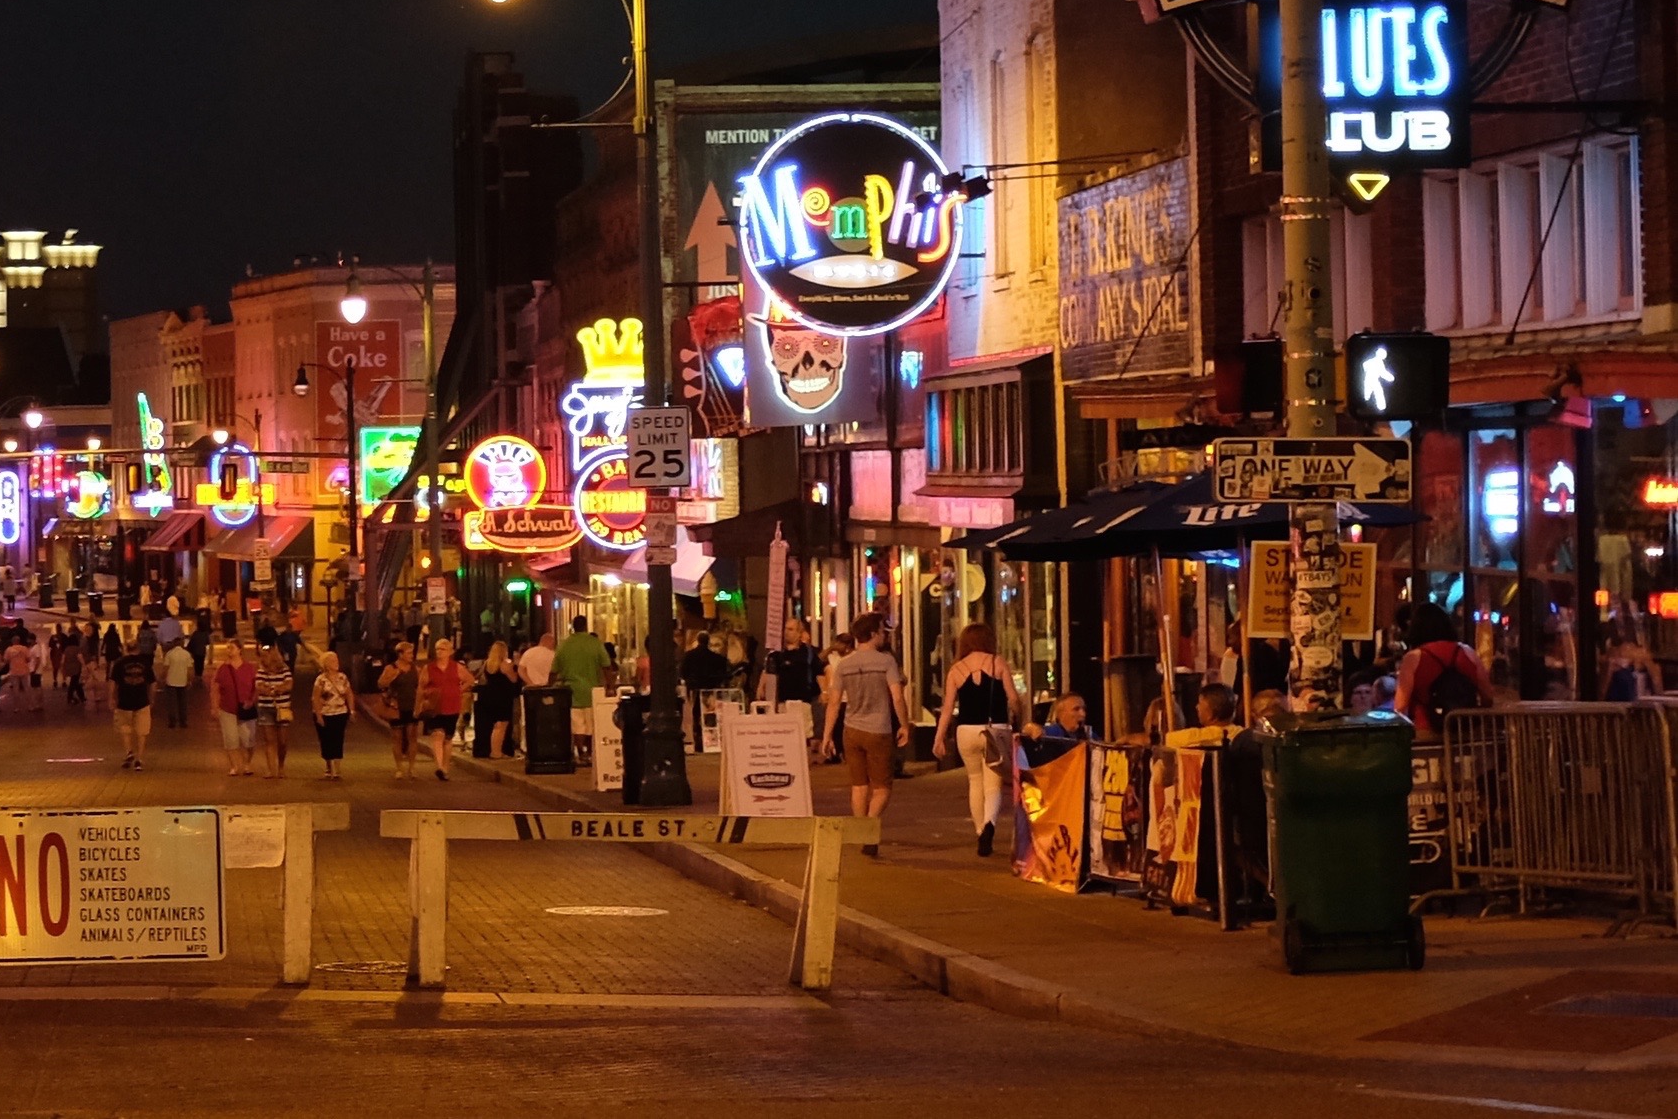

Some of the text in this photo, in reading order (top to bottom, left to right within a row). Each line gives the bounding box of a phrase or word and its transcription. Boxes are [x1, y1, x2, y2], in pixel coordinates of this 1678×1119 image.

[1322, 6, 1452, 98] LUES
[705, 129, 769, 144] MENTION
[1325, 110, 1452, 153] LUB
[738, 161, 967, 267] Memphis
[707, 285, 738, 299] JUS
[330, 327, 386, 341] Have a
[327, 346, 388, 368] Coke
[632, 416, 684, 429] SPEED
[638, 433, 678, 445] LIMIT
[601, 460, 627, 479] BA
[634, 450, 684, 479] 25
[1303, 459, 1354, 481] WAY
[651, 500, 670, 511] NO
[1182, 503, 1262, 526] Lite
[79, 827, 141, 842] VEHICLES
[570, 819, 698, 838] BEALE ST.
[79, 847, 141, 862] BICYCLES
[79, 867, 127, 882] SKATES
[79, 887, 171, 902] SKATEBOARDS
[79, 907, 206, 922] GLASS CONTAINERS
[186, 944, 208, 953] MPD
